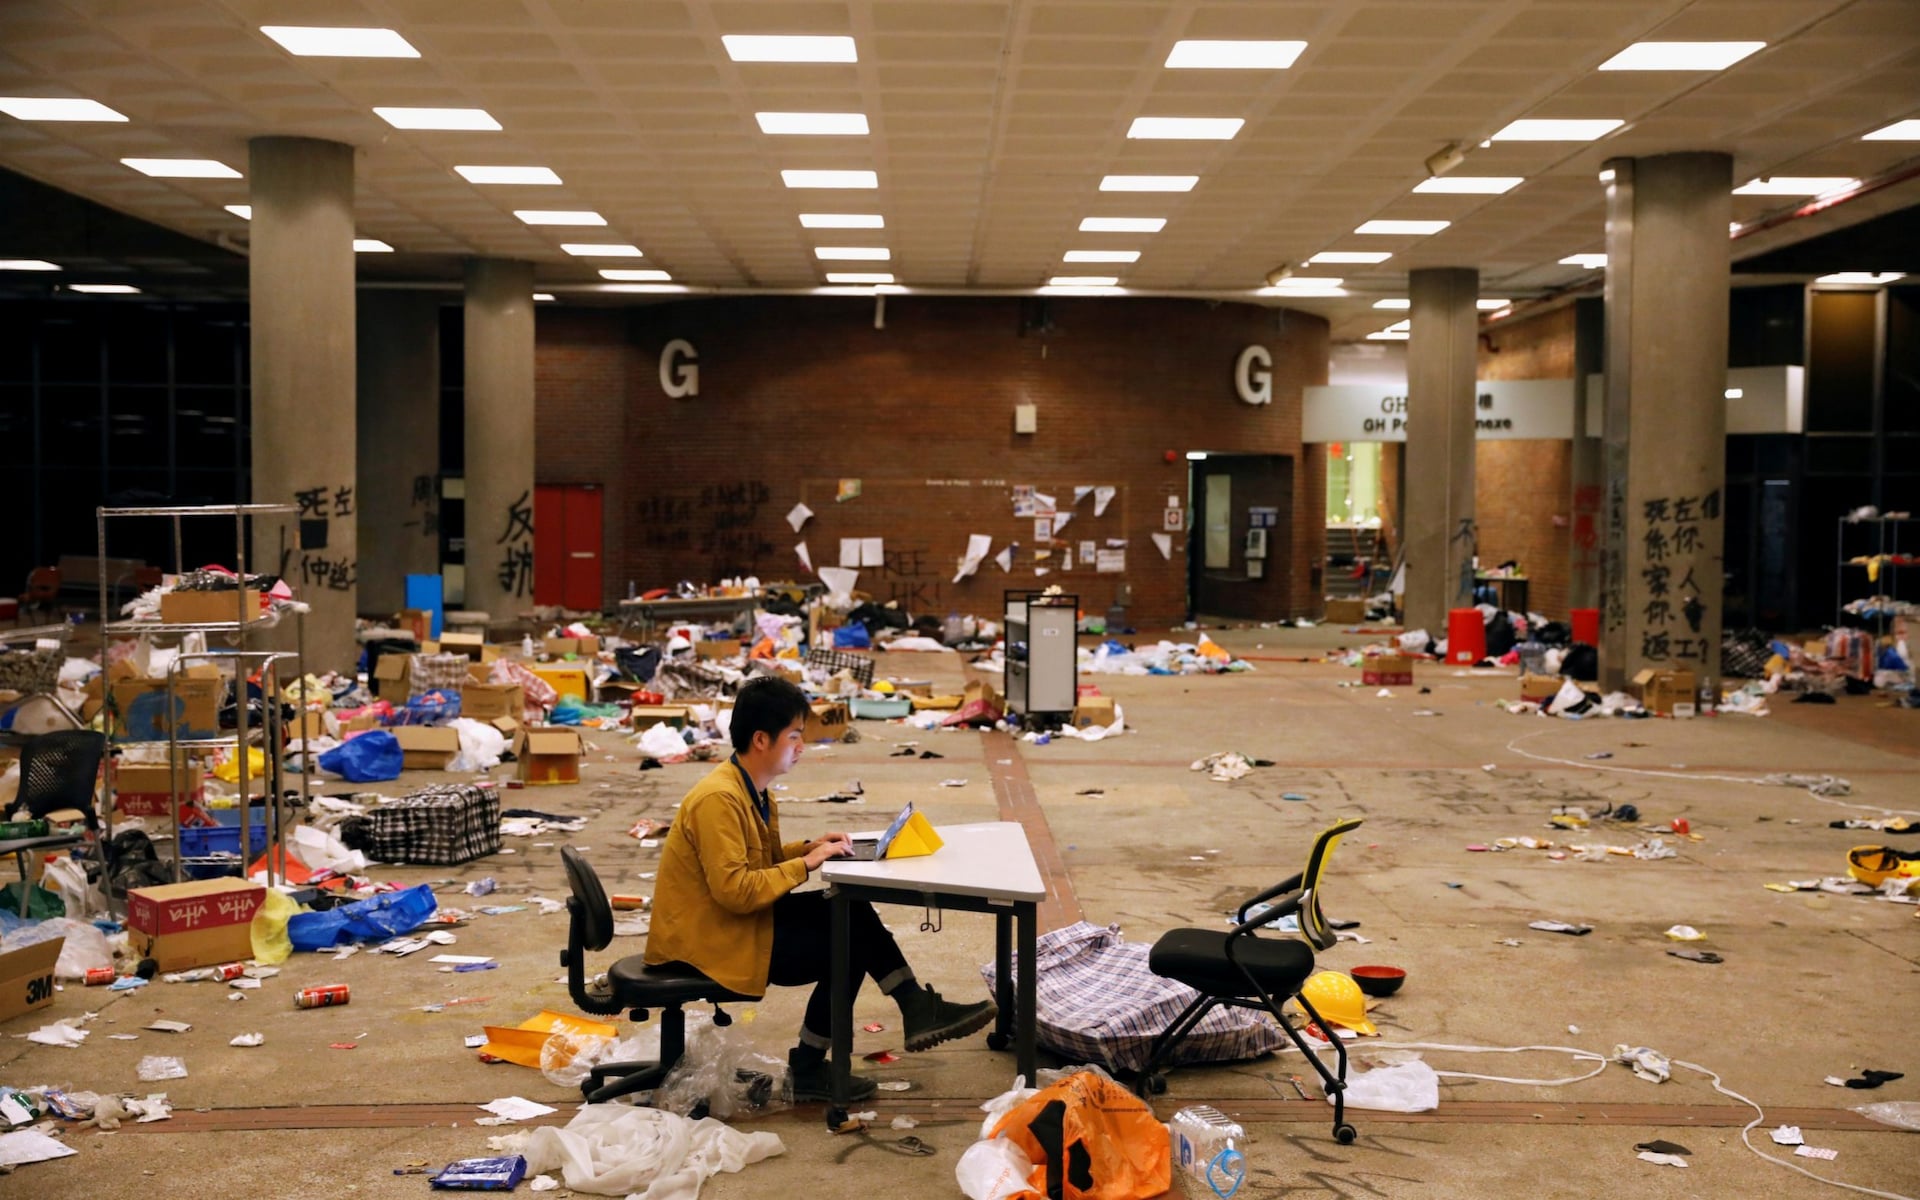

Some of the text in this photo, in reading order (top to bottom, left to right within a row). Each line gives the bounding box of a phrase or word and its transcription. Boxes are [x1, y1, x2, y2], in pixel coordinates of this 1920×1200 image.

[657, 338, 699, 399] G
[1234, 344, 1273, 404] G
[1380, 396, 1409, 413] GH
[1363, 418, 1386, 432] GH
[820, 708, 845, 726] 3M
[123, 795, 153, 810] vita
[169, 906, 208, 928] vita
[217, 897, 255, 922] vita
[25, 973, 53, 1005] 3M
